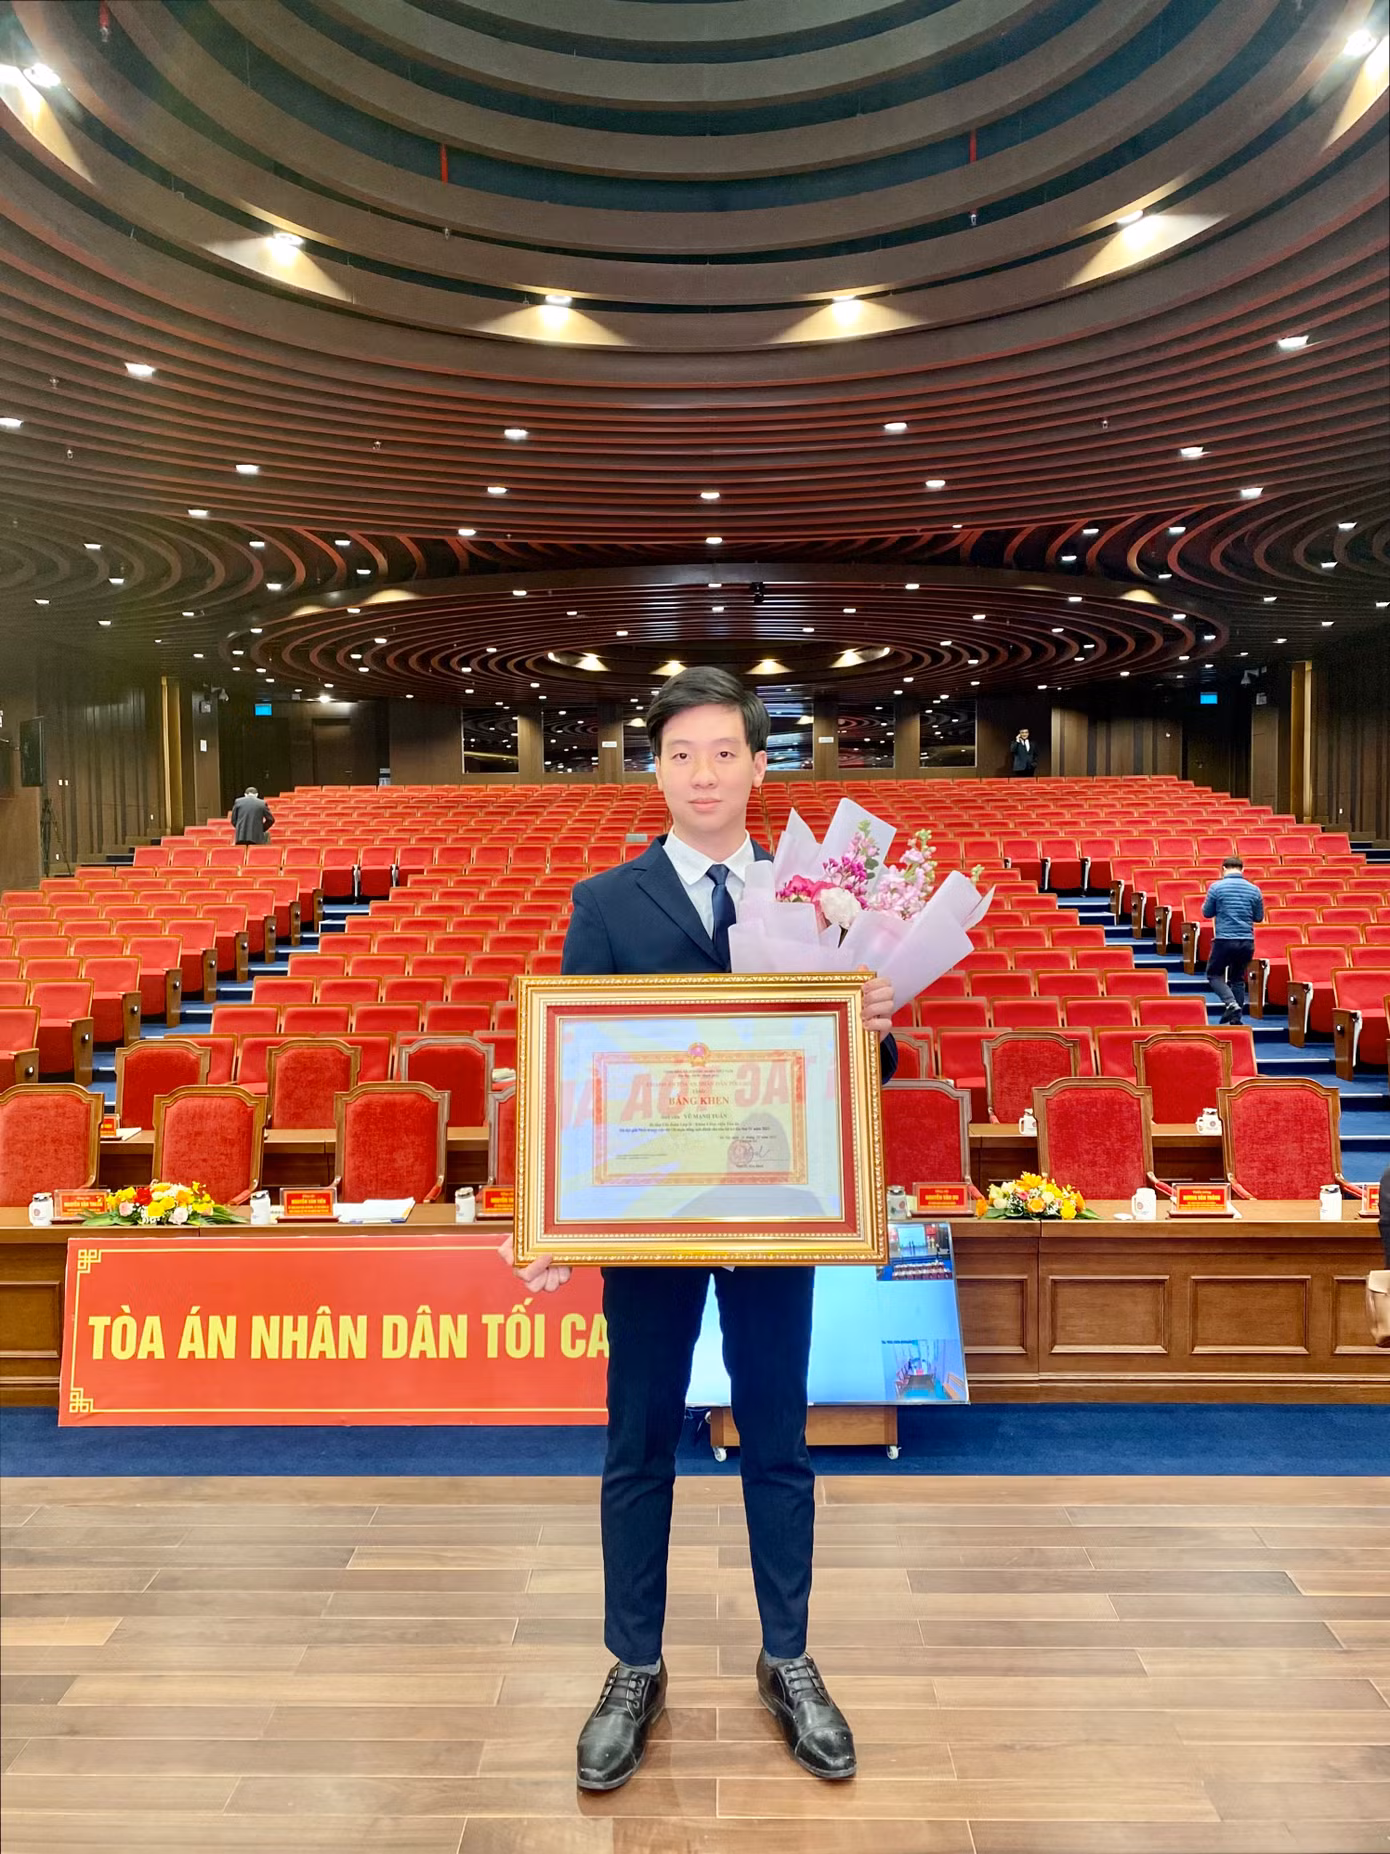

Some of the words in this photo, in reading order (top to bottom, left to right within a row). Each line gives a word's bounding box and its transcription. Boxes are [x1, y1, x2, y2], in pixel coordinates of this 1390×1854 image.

[700, 1096, 729, 1105] KHEN
[88, 1305, 165, 1360] TÒA
[177, 1305, 237, 1360] ÁN
[250, 1305, 367, 1360] NHÂN
[382, 1304, 468, 1359] DÂN
[481, 1297, 545, 1358] TỐI
